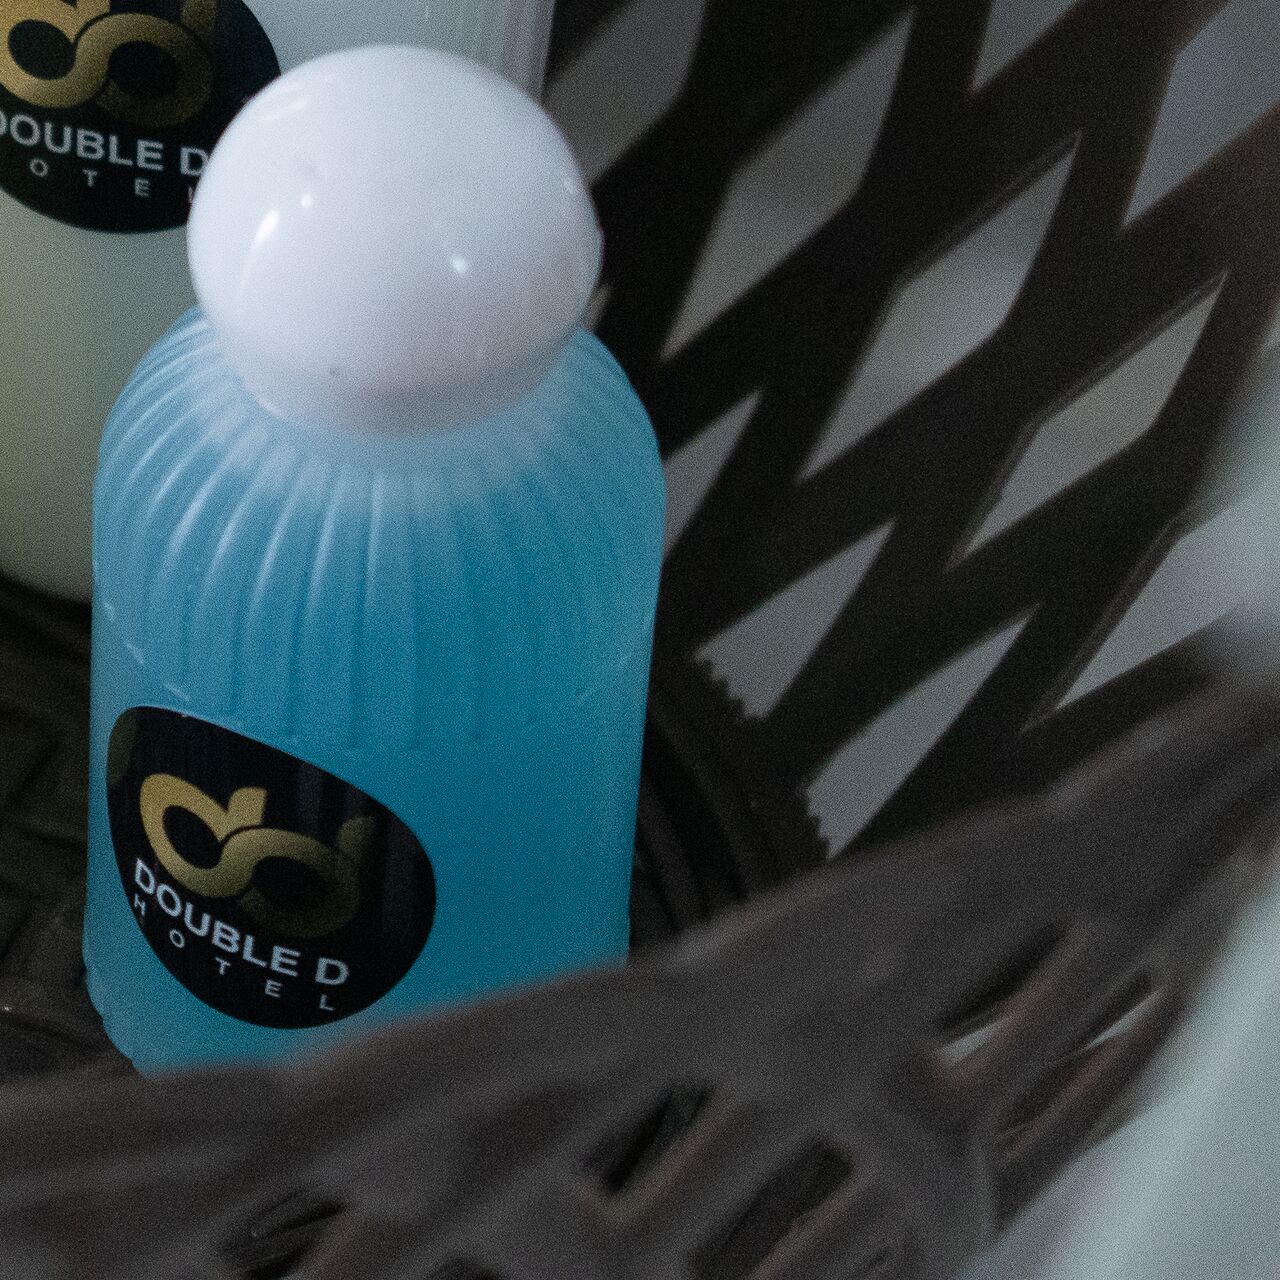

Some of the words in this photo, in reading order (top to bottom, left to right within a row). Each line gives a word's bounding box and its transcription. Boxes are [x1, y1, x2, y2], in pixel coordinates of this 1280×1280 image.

[180, 146, 209, 177] D
[133, 892, 335, 1012] HOTEL
[134, 857, 302, 977] DOUBLE
[314, 956, 350, 986] D
